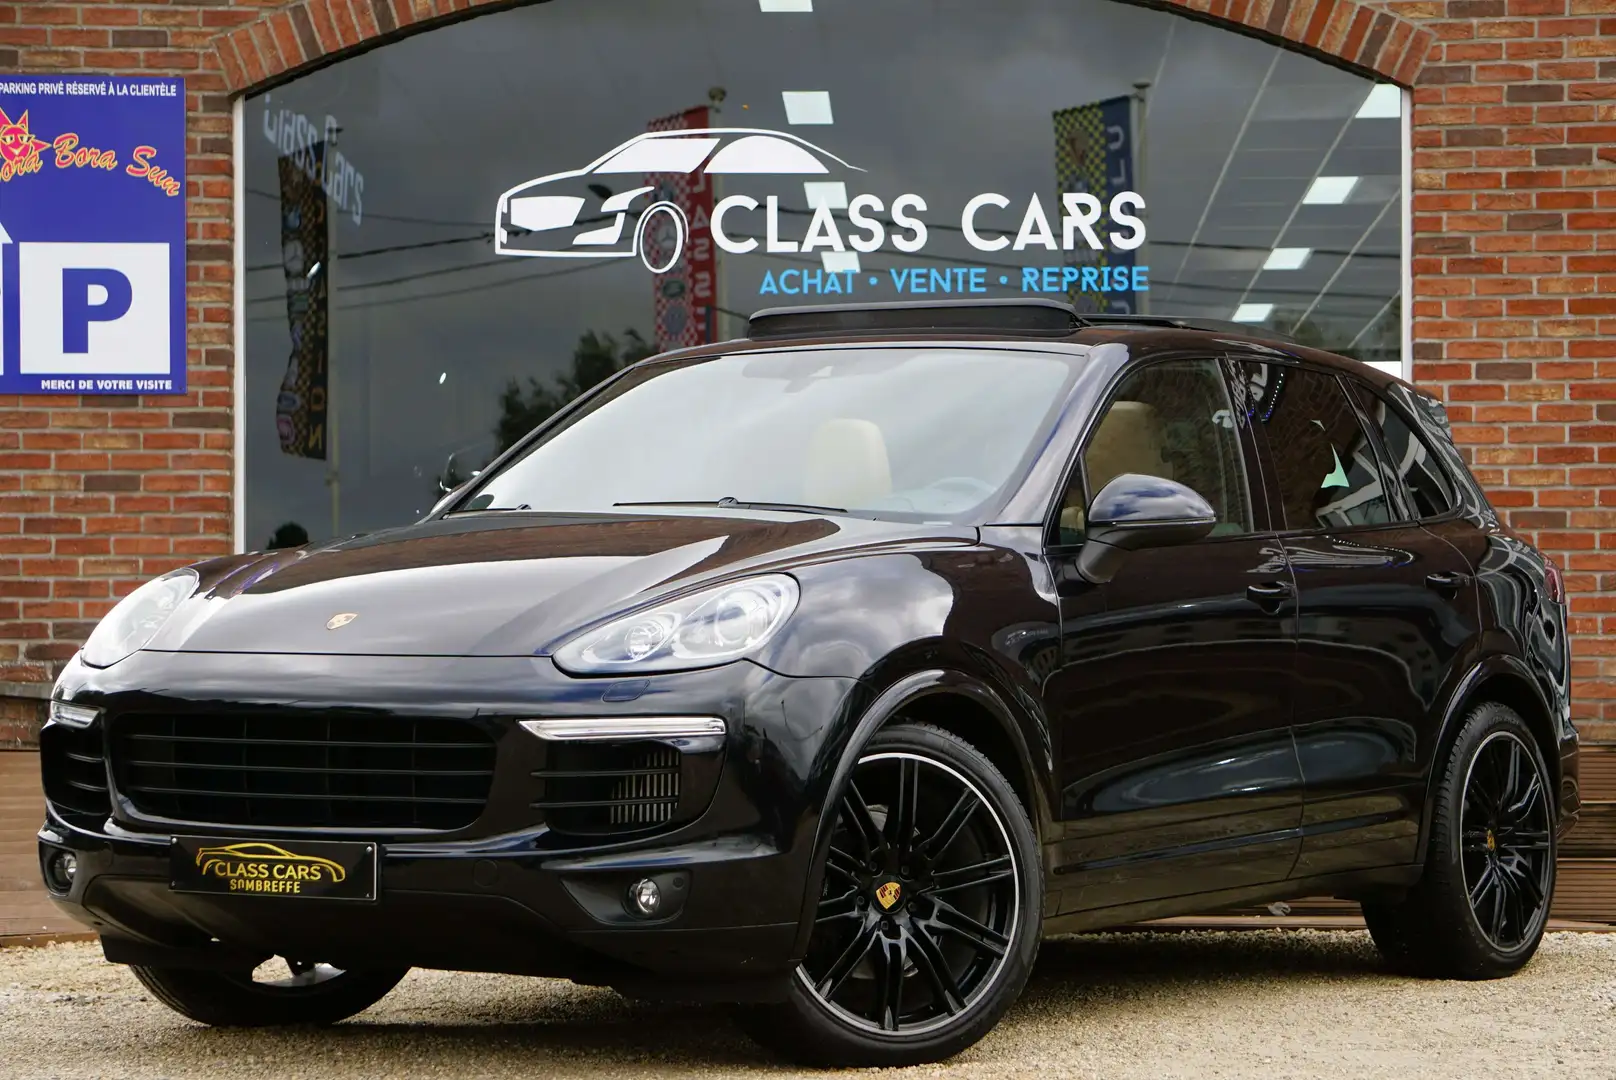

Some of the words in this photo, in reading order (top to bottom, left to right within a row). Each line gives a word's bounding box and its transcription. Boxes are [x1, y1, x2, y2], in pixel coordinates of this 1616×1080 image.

[0, 82, 37, 95] PARKING
[38, 80, 64, 95] PRIVÉ
[66, 81, 107, 96] RÉSERVÉ
[108, 81, 116, 96] À
[117, 84, 128, 96] LA
[130, 82, 177, 97] CLIENTÈLE
[0, 151, 43, 182] ora
[53, 132, 119, 170] Bora
[126, 145, 181, 197] Sun
[321, 115, 364, 226] Cars
[710, 193, 928, 254] CLASS
[961, 191, 1147, 252] CARS
[759, 269, 857, 295] ACHAT
[890, 268, 987, 294] VENTE
[1021, 265, 1150, 292] REPRISE
[62, 268, 132, 353] P
[41, 379, 75, 390] MERCI
[78, 379, 94, 390] DE
[97, 379, 133, 390] VOTRE
[136, 379, 172, 390] VISITE
[215, 861, 269, 878] CLASS
[273, 863, 322, 881] CARS
[229, 878, 301, 894] SOMBREFFE
